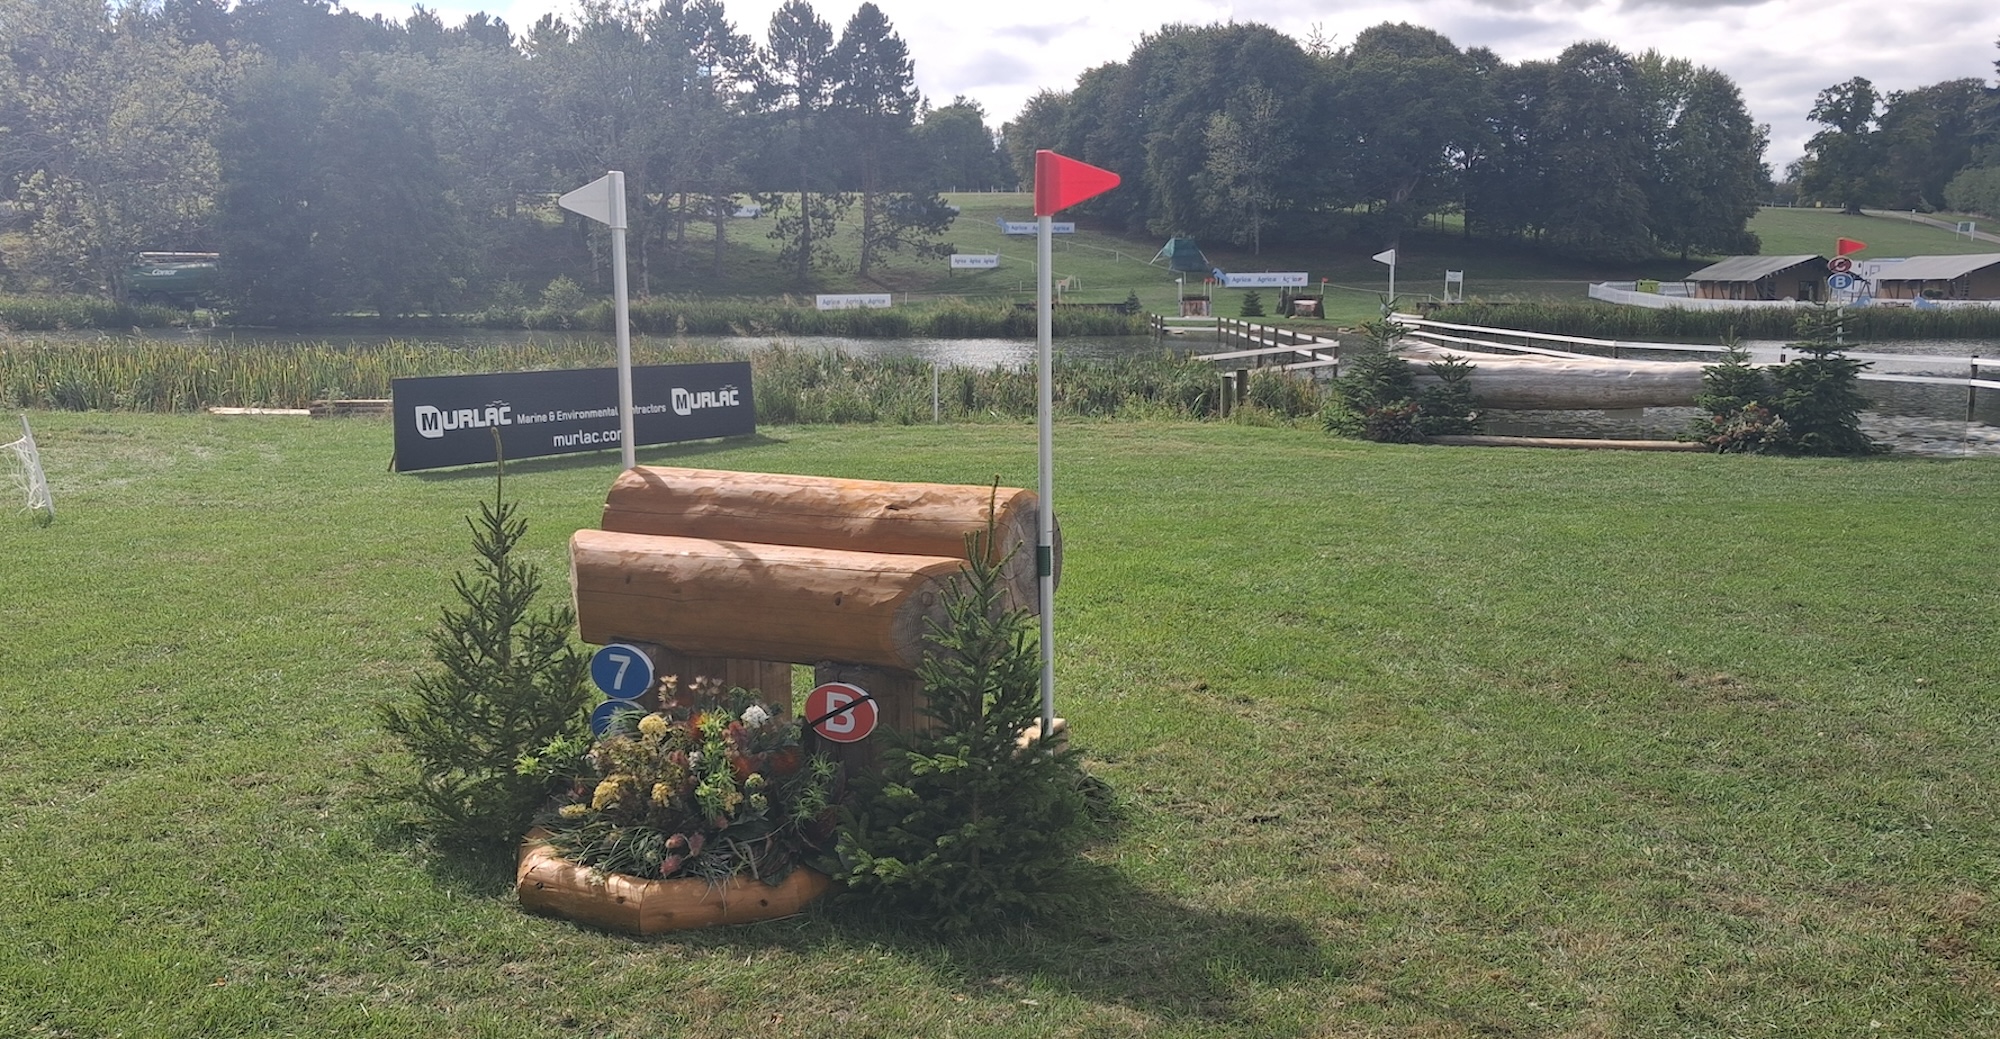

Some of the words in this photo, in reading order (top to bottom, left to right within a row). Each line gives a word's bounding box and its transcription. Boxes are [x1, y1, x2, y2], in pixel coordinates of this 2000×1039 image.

[1835, 259, 1847, 271] C
[1836, 276, 1847, 287] B
[517, 413, 548, 424] Marine
[549, 411, 555, 421] &
[557, 406, 618, 420] Environmental
[632, 404, 666, 415] ntractors
[671, 388, 739, 415] MURLAC
[415, 405, 512, 438] MURLAC
[609, 653, 631, 690] 7
[826, 692, 855, 733] B
